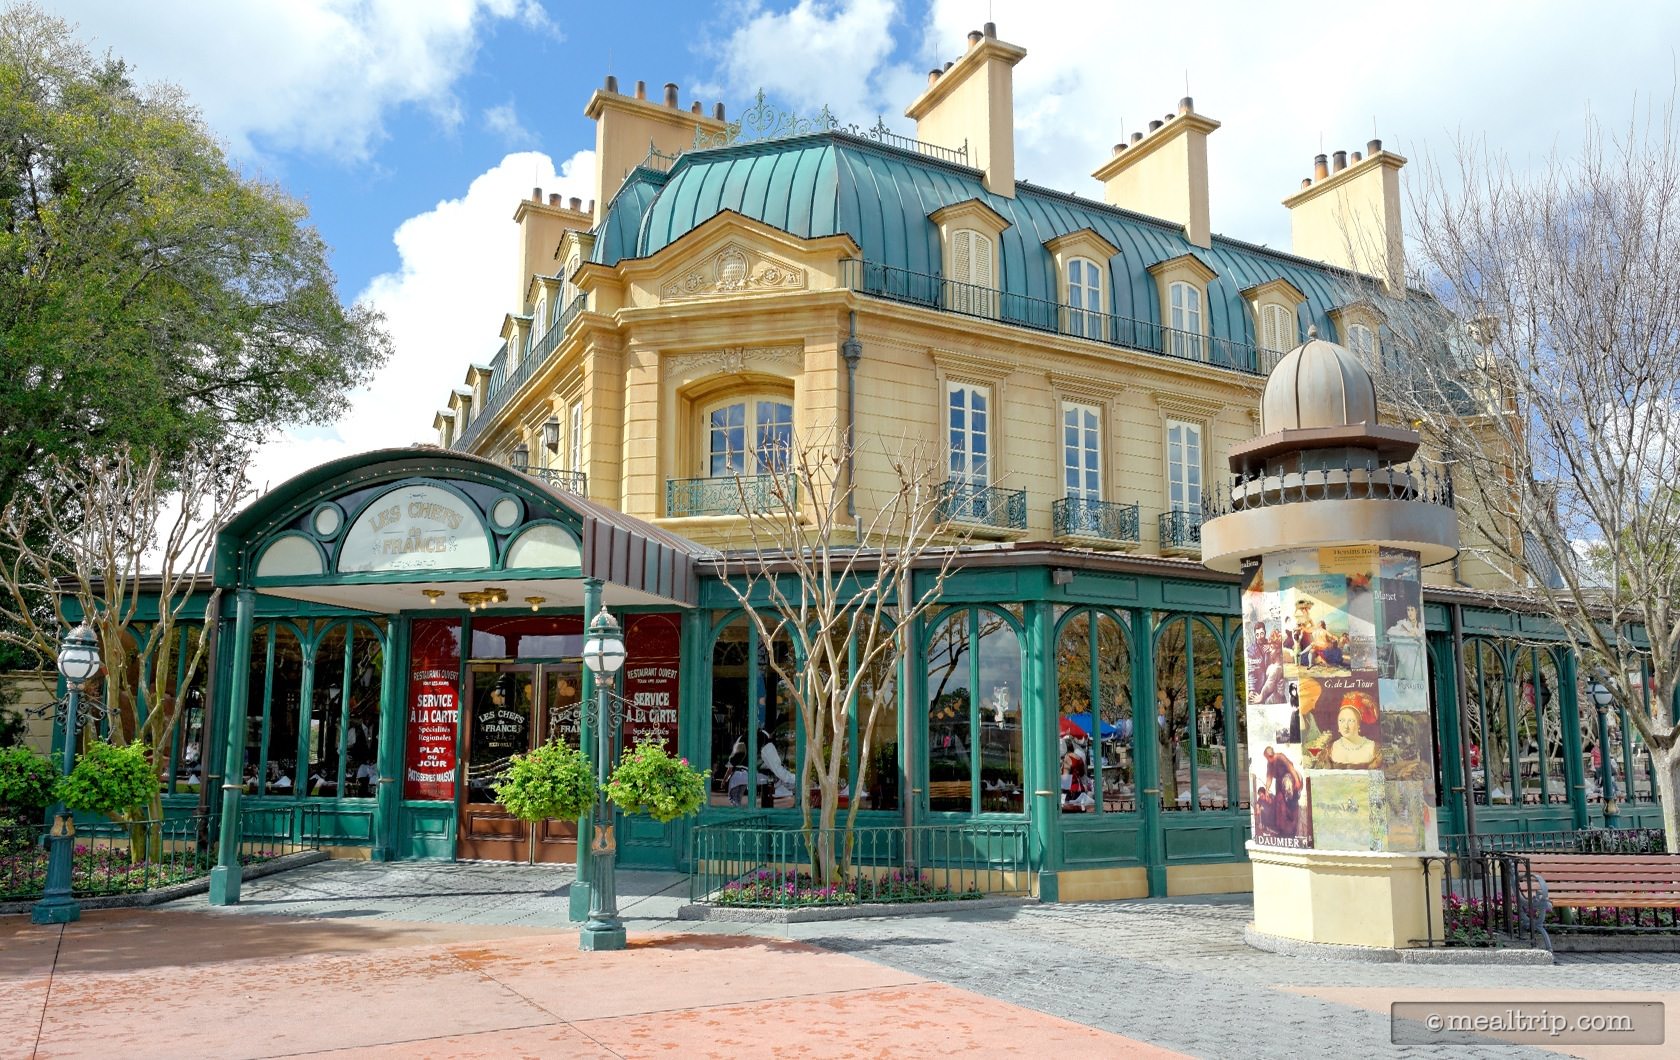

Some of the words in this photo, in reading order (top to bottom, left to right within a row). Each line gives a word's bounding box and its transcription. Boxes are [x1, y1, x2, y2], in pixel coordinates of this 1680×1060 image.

[368, 505, 402, 532] LES
[407, 501, 464, 529] CHEFS
[383, 536, 447, 555] FRANCE
[413, 669, 441, 681] RESTAURANT
[441, 669, 459, 681] OUVERT
[627, 667, 657, 680] RESTAURANT
[658, 667, 678, 680] OUVERT
[1344, 679, 1355, 688] La
[1356, 679, 1374, 688] Tour
[417, 693, 453, 708] SERVICE
[634, 692, 670, 706] SERVICE
[410, 706, 416, 723] À
[418, 710, 429, 723] LA
[431, 710, 459, 723] CARTE
[478, 711, 495, 723] LES
[497, 709, 525, 724] CHEFS
[485, 724, 517, 733] FRANCE
[419, 746, 447, 754] PLAT
[436, 768, 456, 783] MAISON
[1258, 835, 1300, 848] DAUMIER
